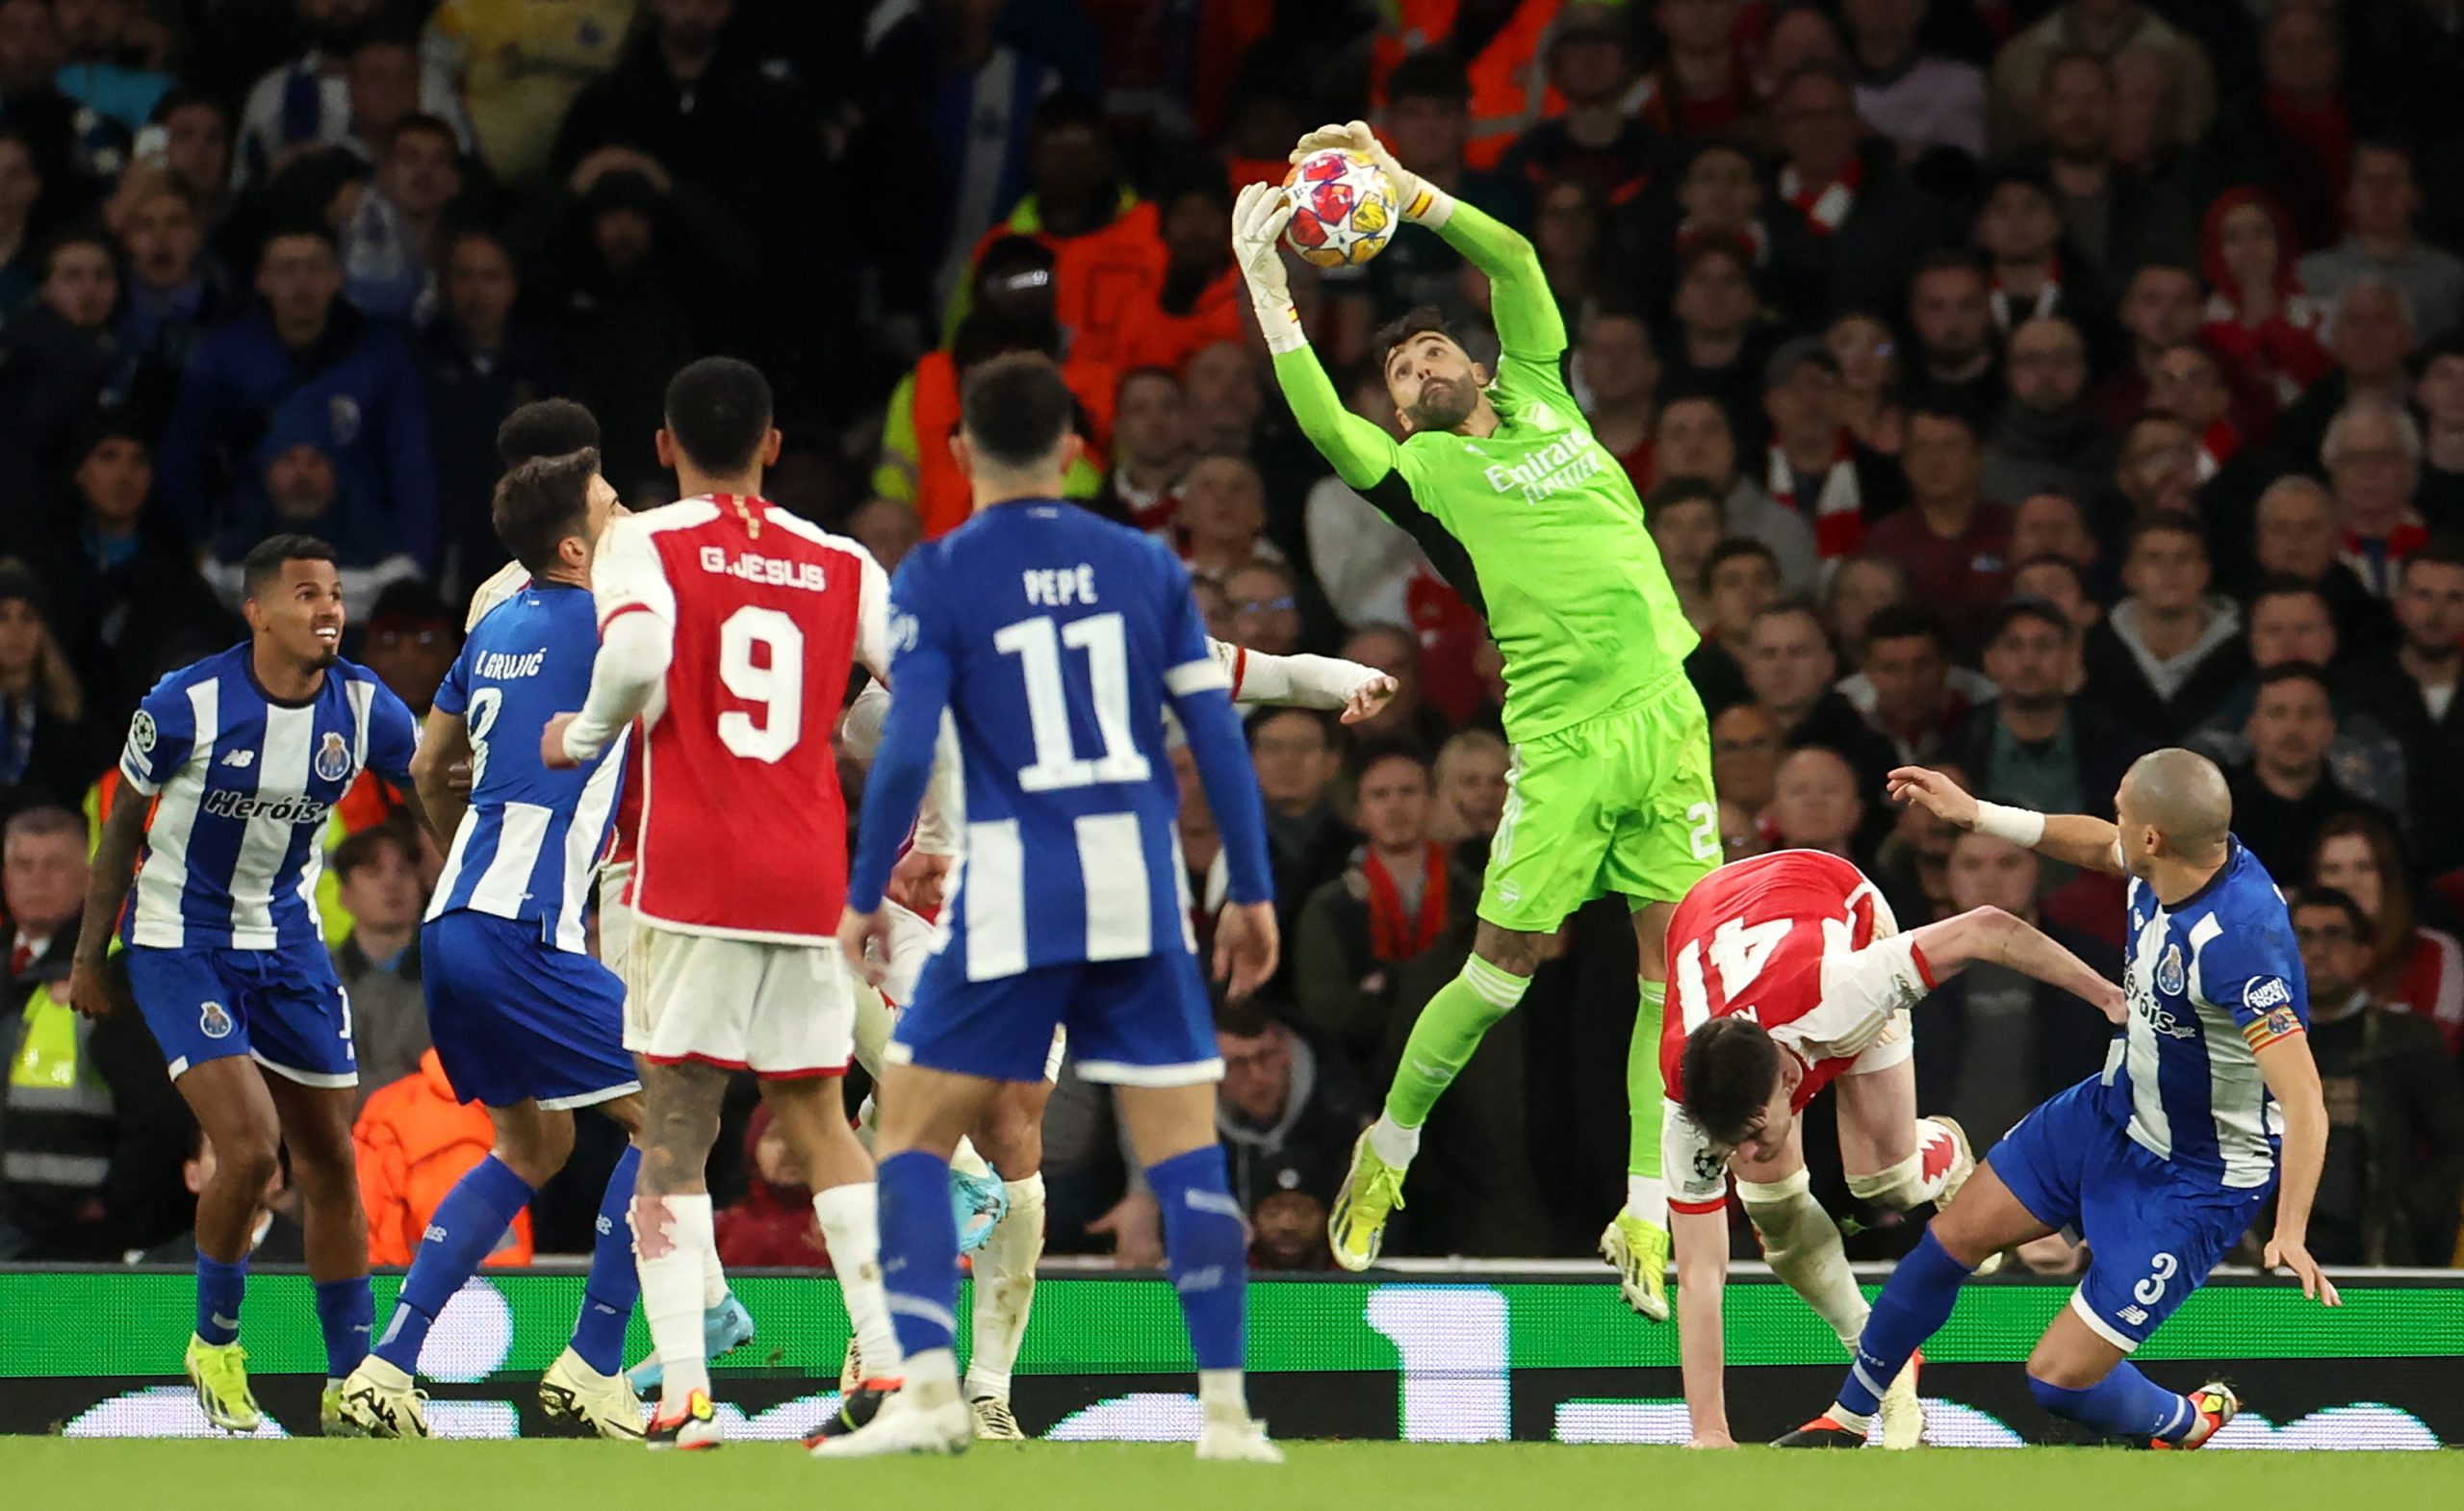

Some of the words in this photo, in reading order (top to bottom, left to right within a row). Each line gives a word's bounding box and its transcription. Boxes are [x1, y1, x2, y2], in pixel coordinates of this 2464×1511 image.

[1483, 427, 1595, 494] Emirate
[700, 546, 826, 592] G.JESUS
[718, 604, 805, 764] 9
[993, 612, 1150, 793] 11
[204, 788, 324, 824] Heróis
[1677, 916, 1793, 1037] 41
[2248, 979, 2280, 1003] SUPER
[2134, 1252, 2178, 1305] 3
